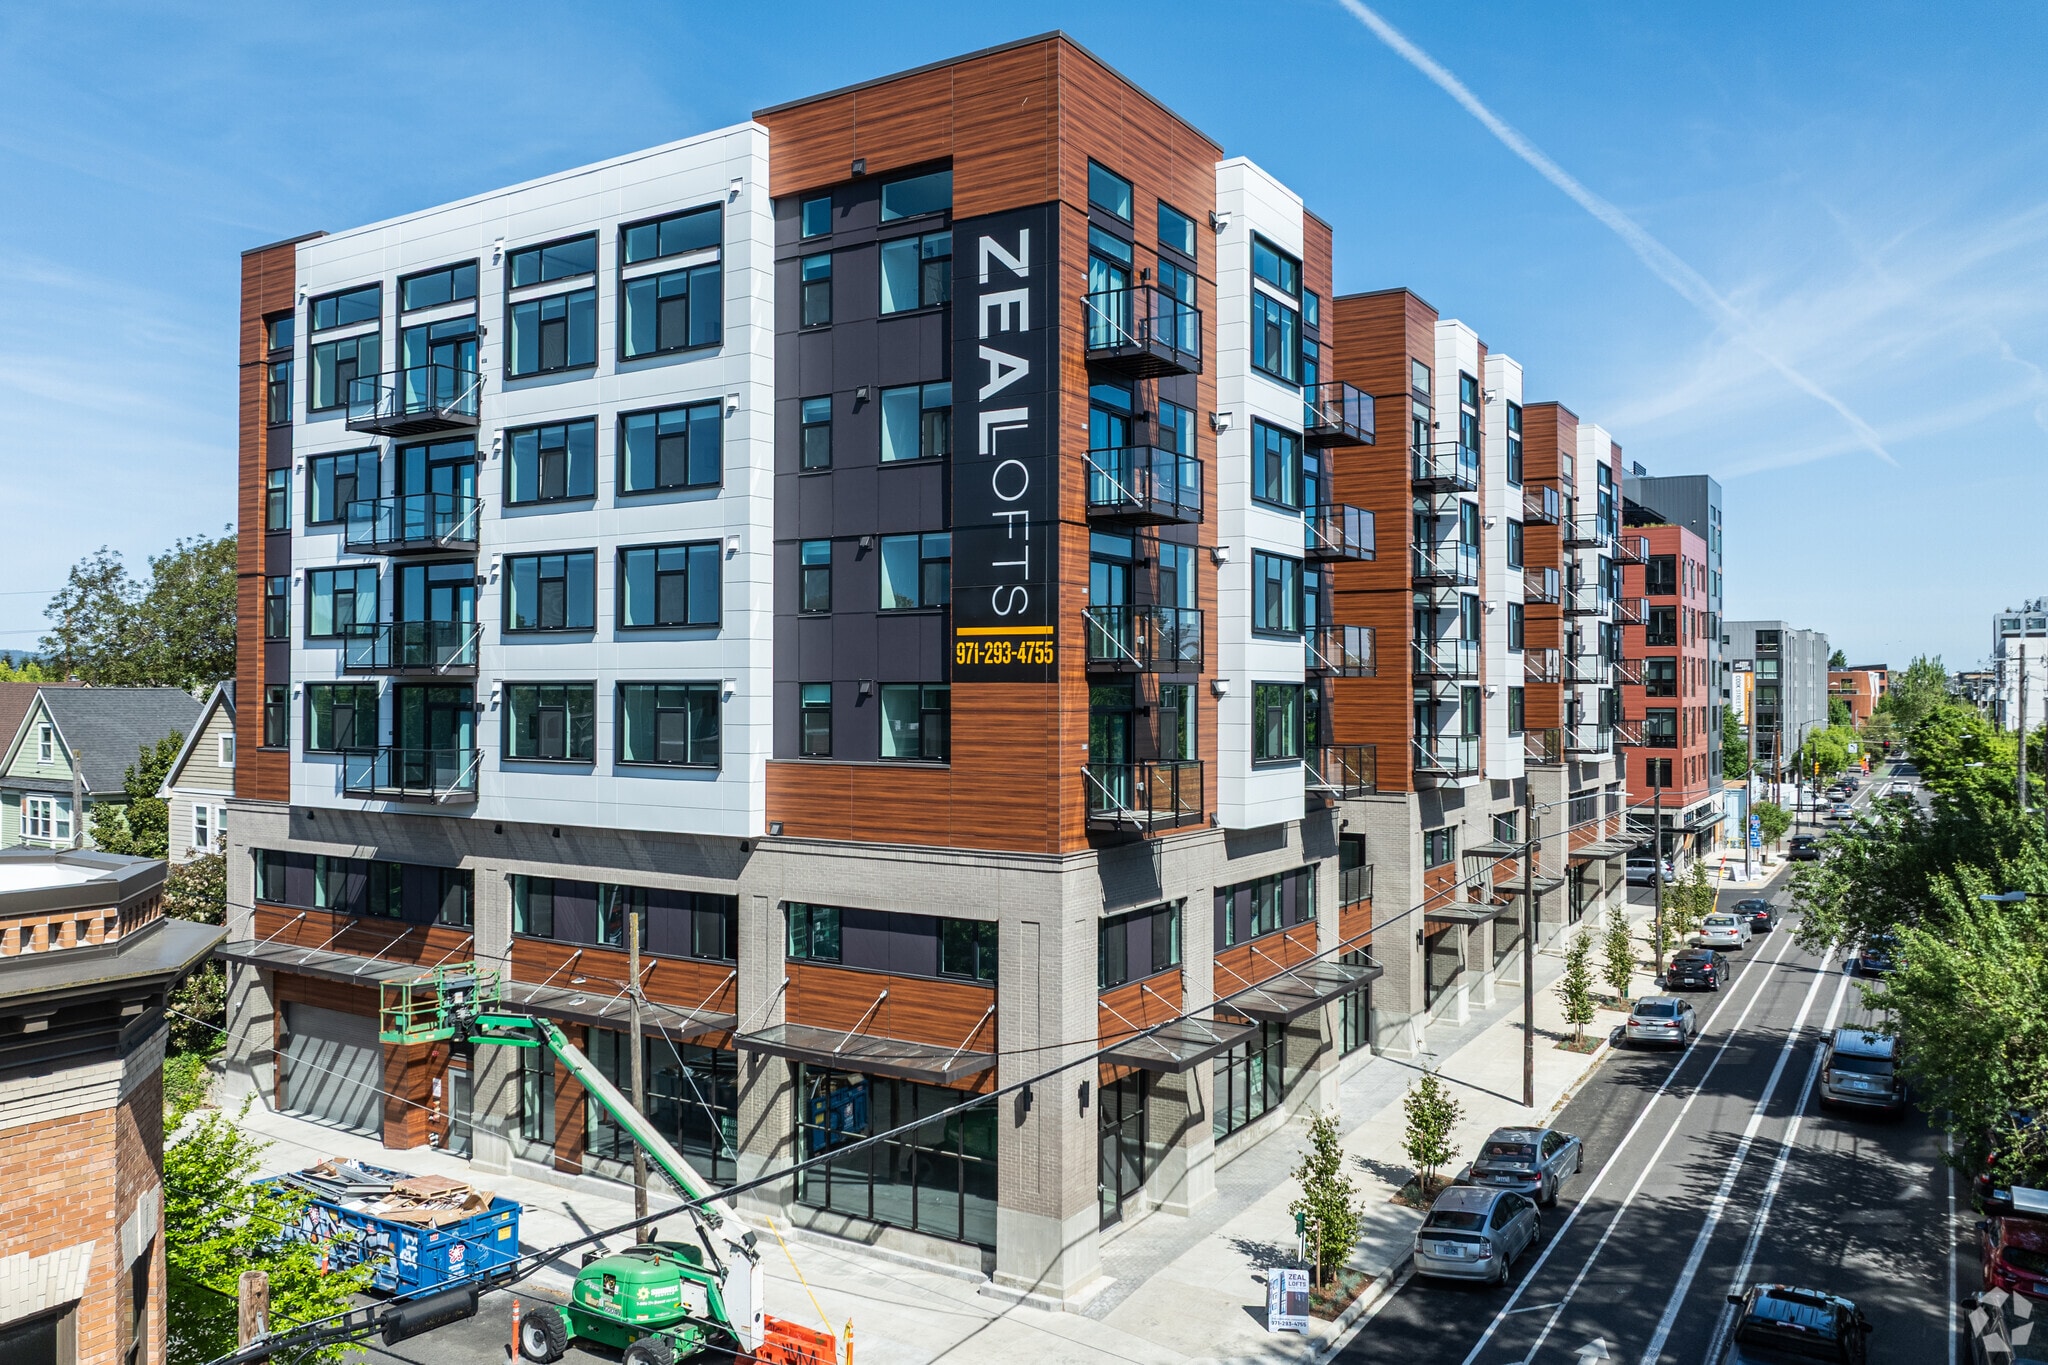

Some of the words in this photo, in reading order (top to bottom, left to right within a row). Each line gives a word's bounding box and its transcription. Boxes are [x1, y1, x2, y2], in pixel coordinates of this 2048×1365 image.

[978, 228, 1029, 456] ZEAL
[992, 423, 1029, 616] LOFTS
[956, 640, 1054, 664] 971-293-4755
